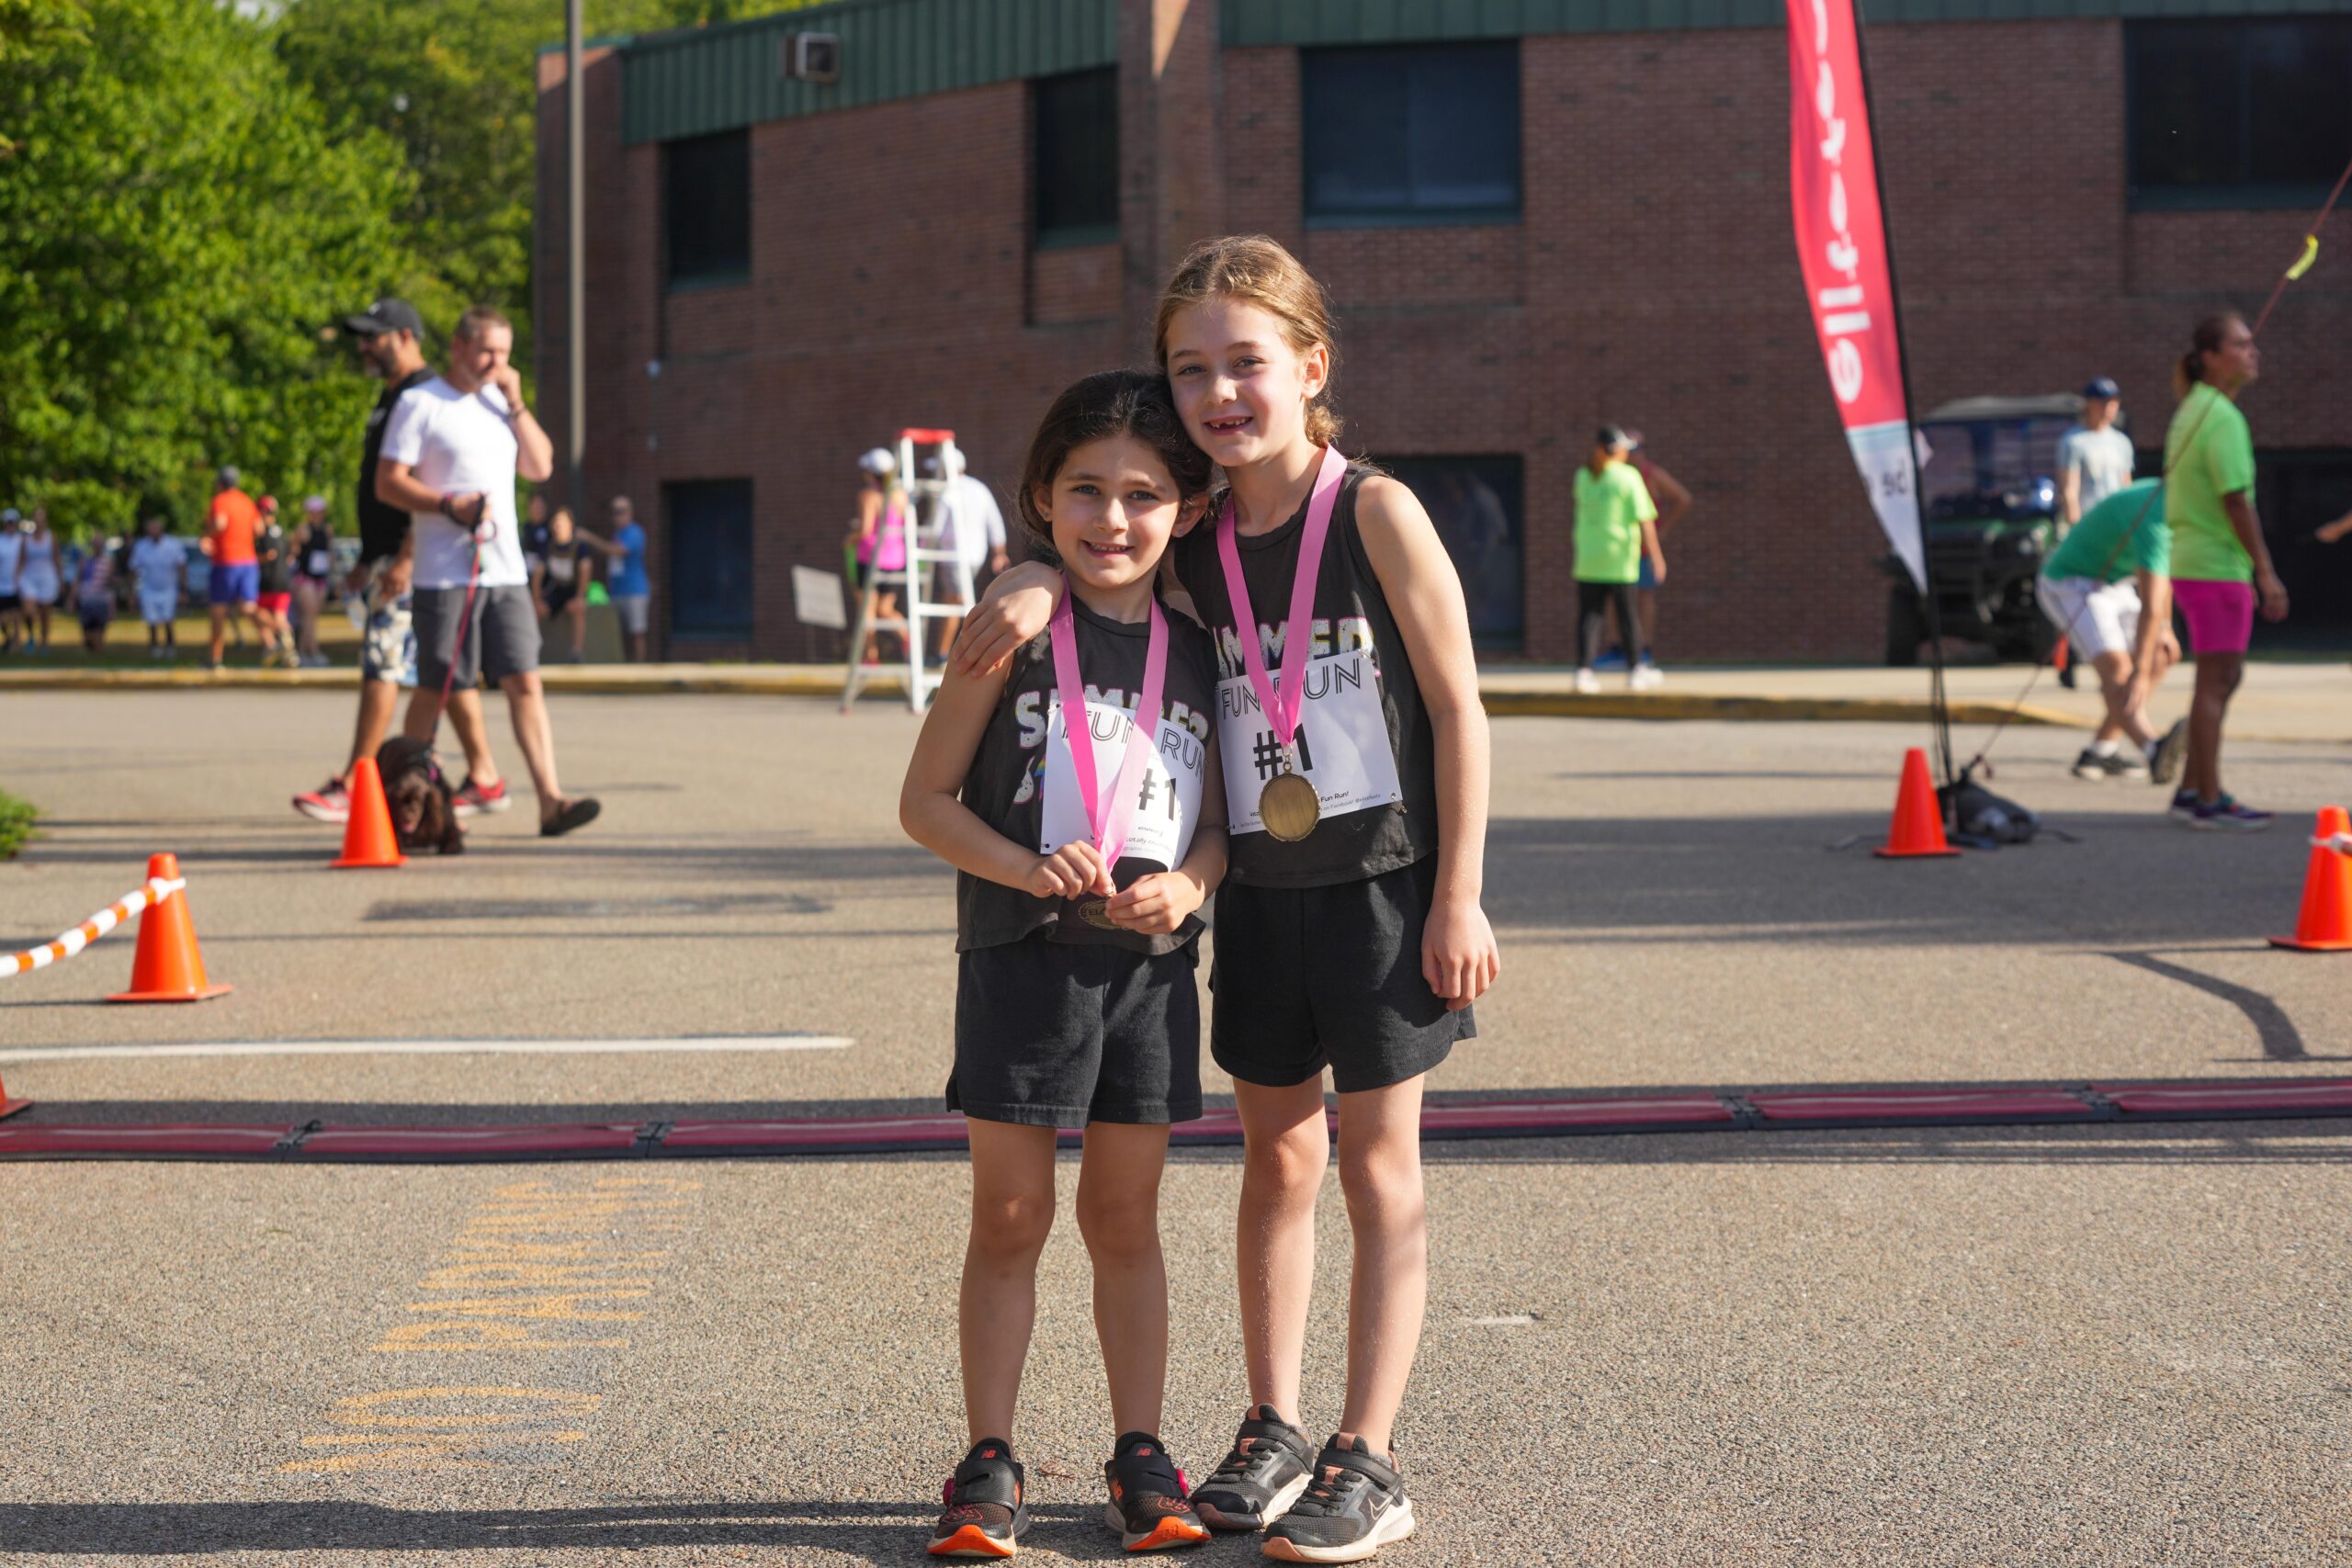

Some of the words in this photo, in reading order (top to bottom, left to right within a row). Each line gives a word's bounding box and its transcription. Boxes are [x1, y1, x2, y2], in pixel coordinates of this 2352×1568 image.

[1273, 658, 1362, 701] UN
[1253, 723, 1313, 781] #1
[370, 1177, 703, 1353] PARKING
[279, 1386, 602, 1473] NO
